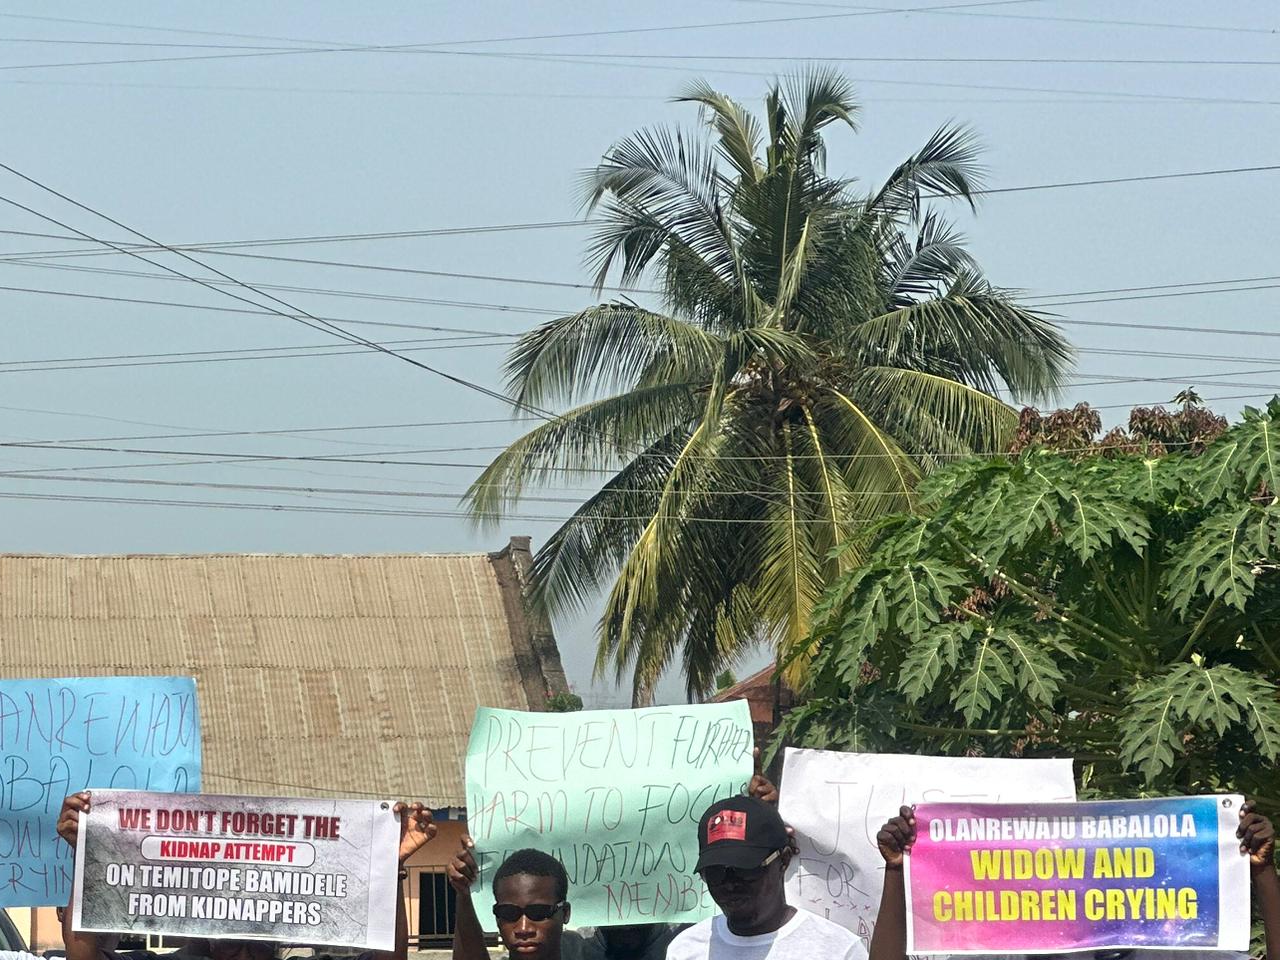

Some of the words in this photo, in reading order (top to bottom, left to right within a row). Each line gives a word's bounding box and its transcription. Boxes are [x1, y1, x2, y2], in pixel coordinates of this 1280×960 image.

[484, 711, 673, 788] PREVENT
[118, 808, 151, 832] WE
[156, 809, 217, 832] DON'T
[222, 811, 302, 836] FORGET
[302, 815, 341, 839] THE
[468, 789, 568, 840] HARM
[584, 786, 624, 833] TO
[929, 817, 1075, 842] OLANREWAJU
[1082, 814, 1196, 839] BABALOLA
[160, 841, 220, 859] KIDNAP
[223, 843, 296, 863] ATTEMPT
[970, 848, 1086, 881] WIDOW
[1093, 847, 1155, 879] AND
[106, 863, 138, 887] ON
[139, 865, 241, 893] TEMITOPE
[244, 869, 348, 898] BAMIDELE
[797, 857, 870, 898] FOR
[128, 892, 187, 918] FROM
[191, 895, 322, 926] KIDNAPPERS
[932, 889, 1077, 922] CHILDREN
[1084, 887, 1198, 920] CRYING
